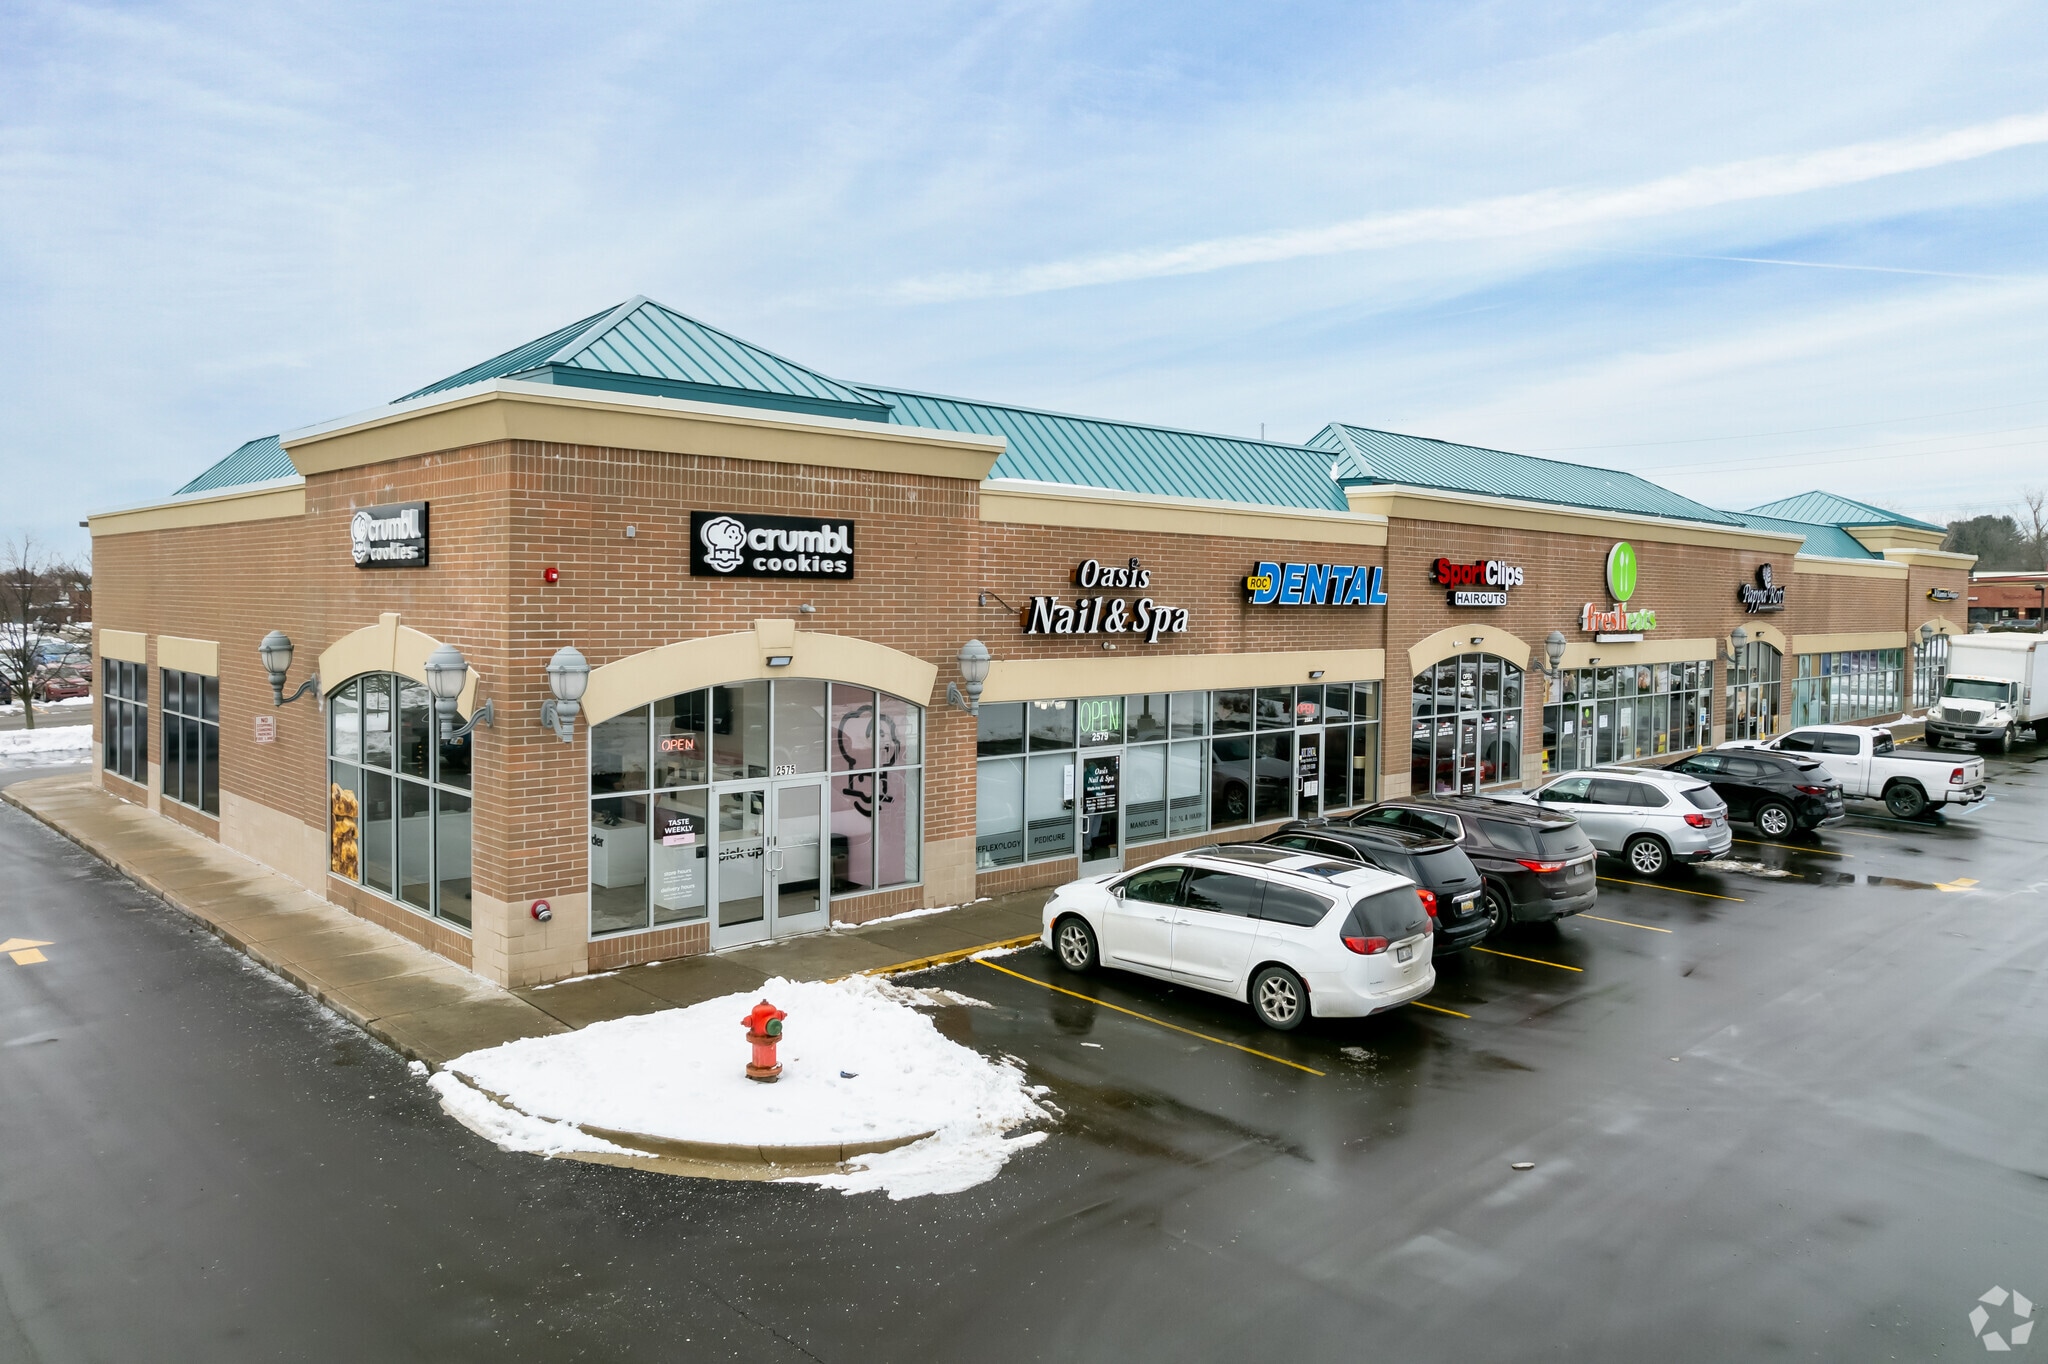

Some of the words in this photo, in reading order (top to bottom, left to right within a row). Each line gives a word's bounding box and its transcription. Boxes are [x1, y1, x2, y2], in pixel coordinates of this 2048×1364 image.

[367, 509, 421, 541] crumbl
[747, 524, 853, 554] crumbl
[371, 542, 419, 560] cookies
[753, 554, 847, 573] cookies
[1079, 557, 1151, 588] Oasis
[1250, 578, 1268, 588] ROC
[1252, 562, 1388, 605] DENTAL
[1456, 593, 1506, 604] HAIRCUTS
[1027, 596, 1103, 634] Nail
[1105, 598, 1130, 633] &
[1132, 598, 1189, 644] Spa
[1080, 701, 1119, 732] OPEN
[1091, 732, 1109, 741] 2579
[661, 738, 695, 751] OPEN
[776, 764, 796, 776] 2575
[664, 824, 693, 834] WEEKLY
[668, 818, 690, 827] TASTE
[1130, 818, 1159, 829] MANICURE
[1034, 833, 1066, 844] PEDICURE
[975, 840, 1022, 853] EFLEXOLOGY
